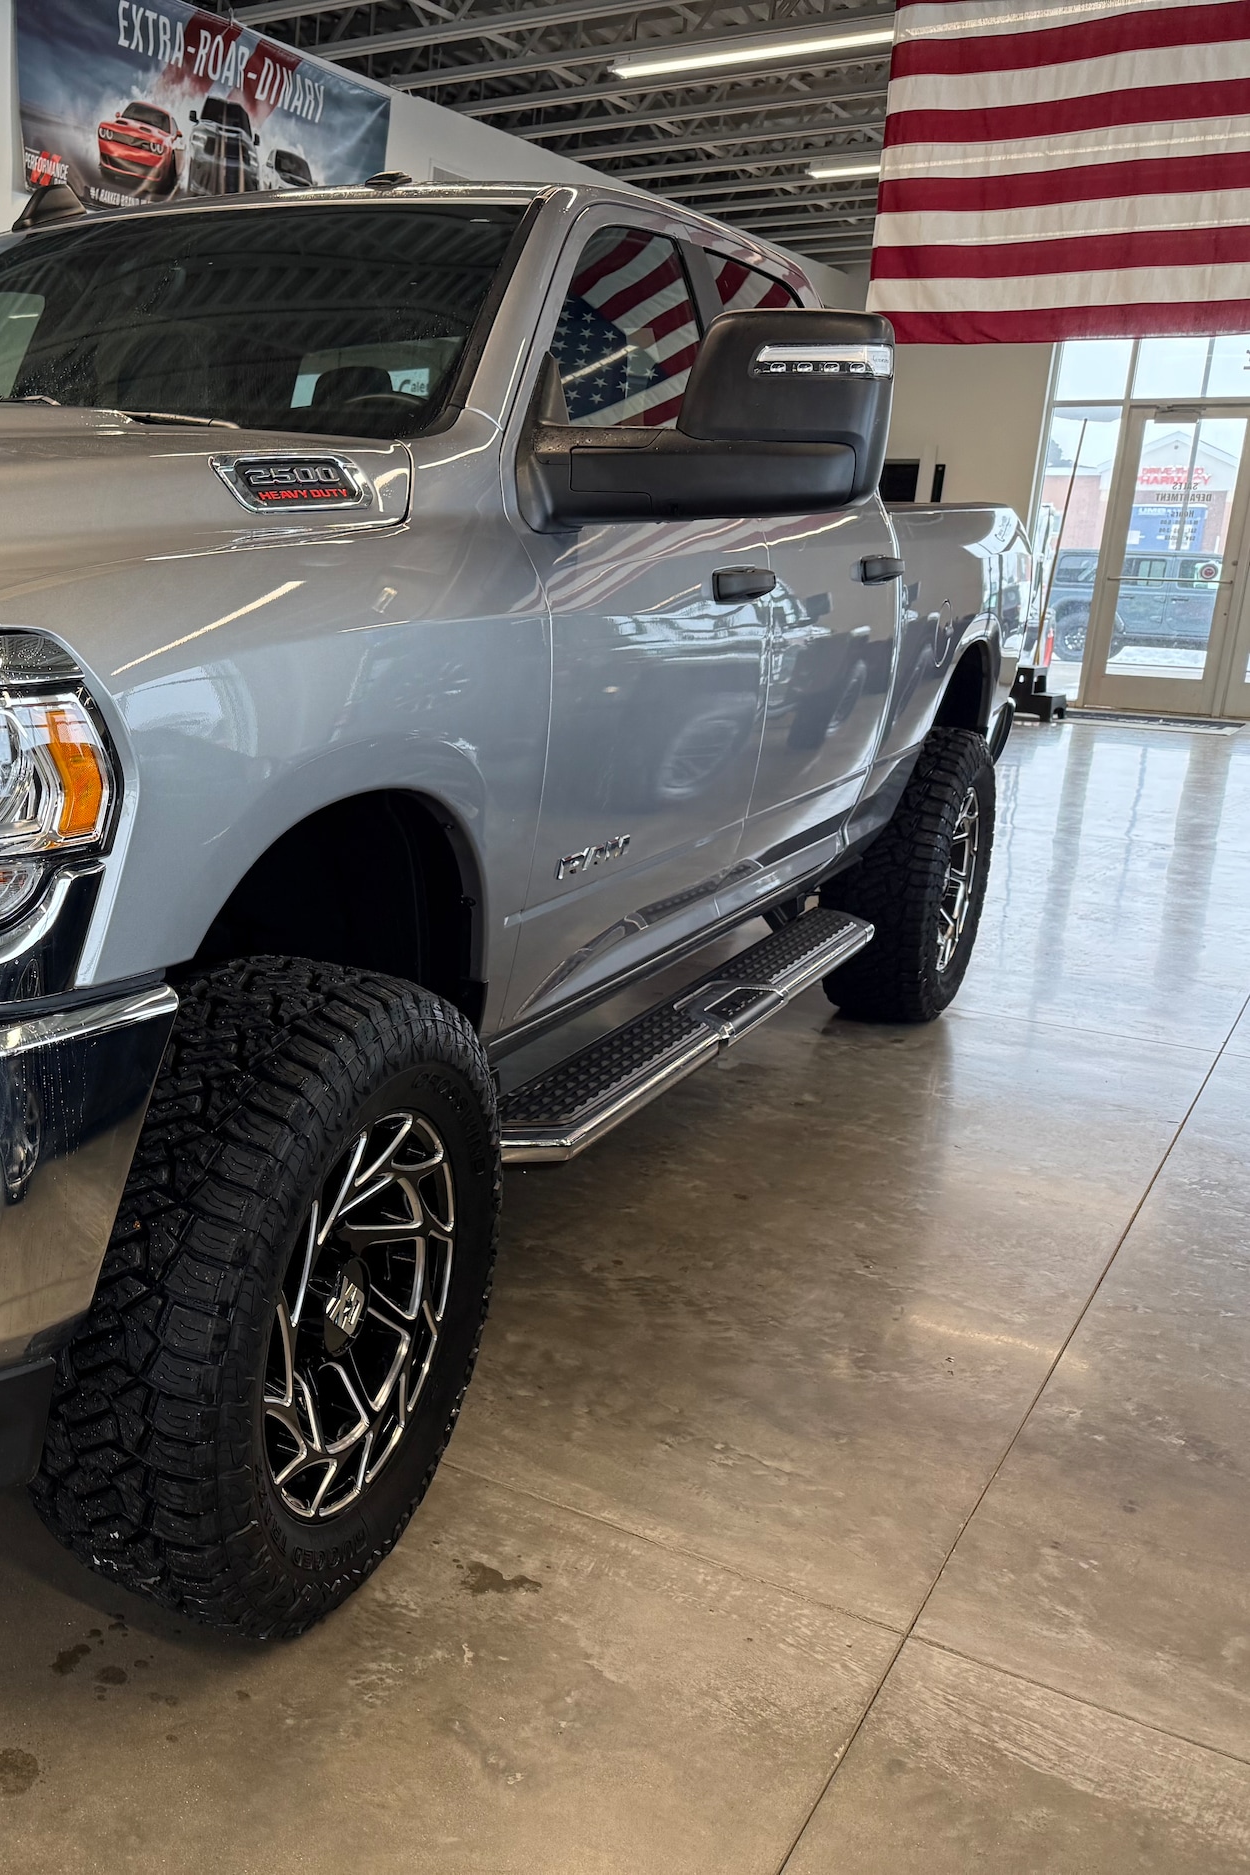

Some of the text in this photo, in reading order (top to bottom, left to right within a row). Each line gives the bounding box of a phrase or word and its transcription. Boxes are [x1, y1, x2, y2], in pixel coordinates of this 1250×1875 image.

[117, 0, 326, 124] EXTRA-ROAR-DINARY
[24, 152, 70, 181] PERFORMANCE
[244, 466, 341, 486] 2500
[258, 488, 348, 500] HEAVY DUTY
